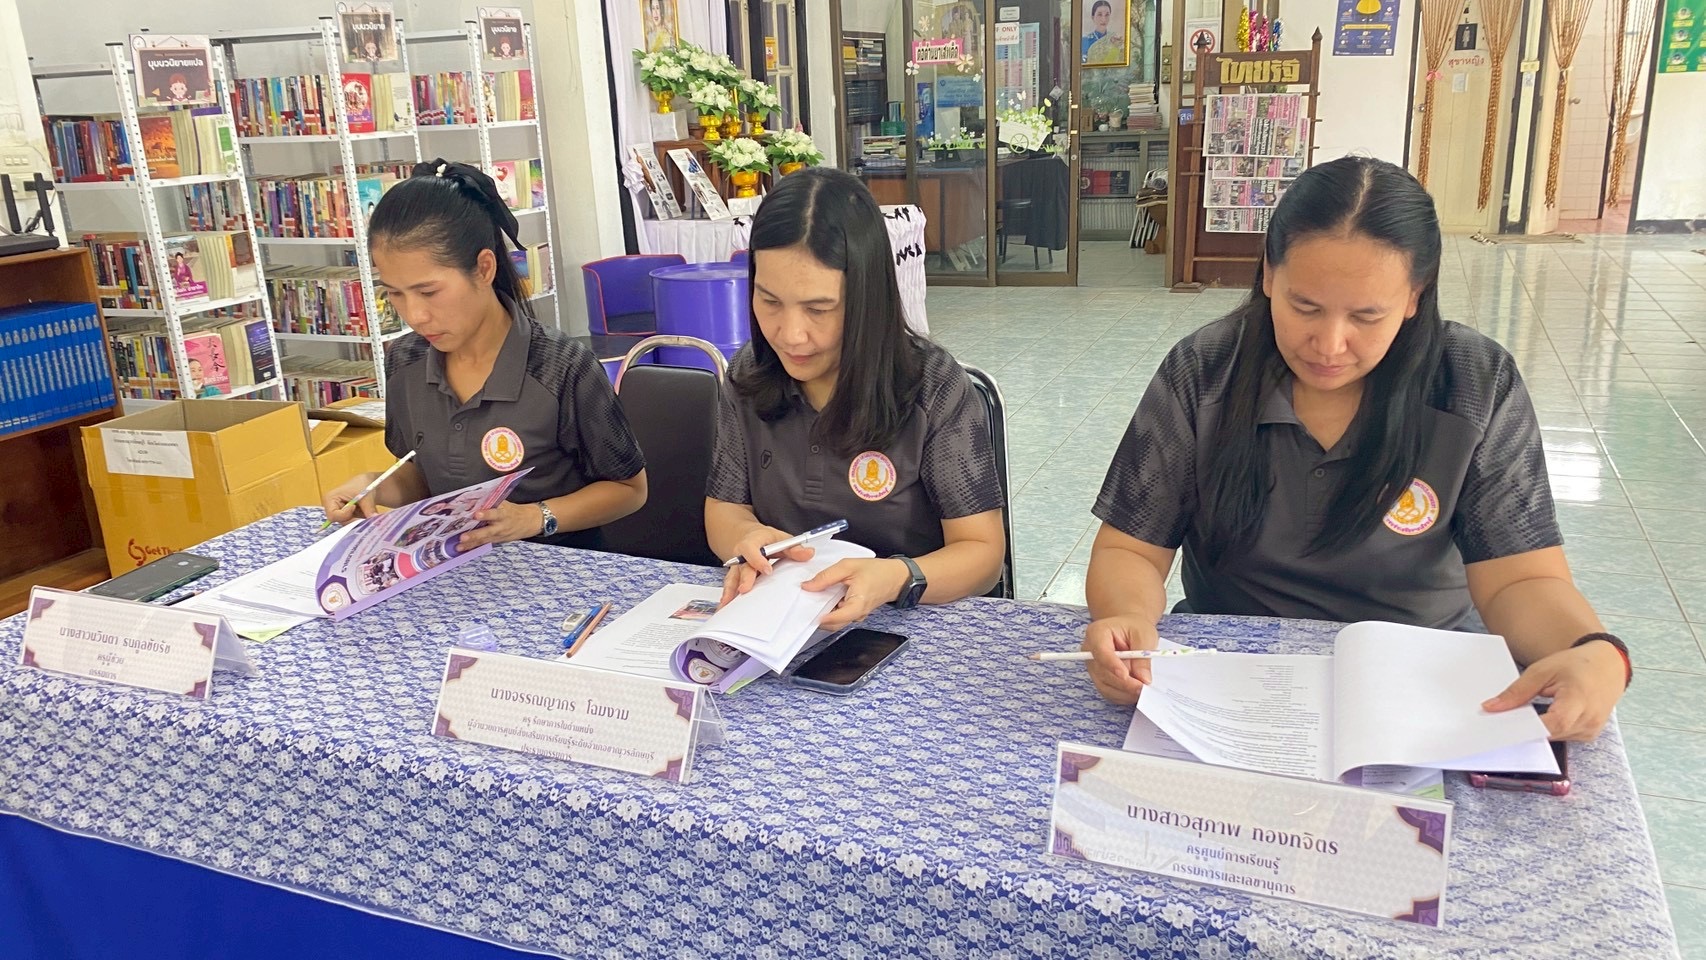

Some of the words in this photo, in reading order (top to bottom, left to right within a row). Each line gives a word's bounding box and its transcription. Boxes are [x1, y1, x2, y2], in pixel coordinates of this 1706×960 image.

[147, 57, 204, 71] มุมนวนิยายแปล
[1216, 56, 1301, 84] ไทยรัฐ
[1448, 54, 1485, 68] สุขาหญิง
[586, 699, 630, 721] โฉมงาม
[533, 715, 594, 735] รักษาการในตำแหน่ง
[1127, 804, 1241, 839] นางสาวสุภาพ
[1186, 844, 1281, 875] ครูศูนย์การเรียนรู้
[1172, 862, 1296, 896] กรรมการและเลขานุการ
